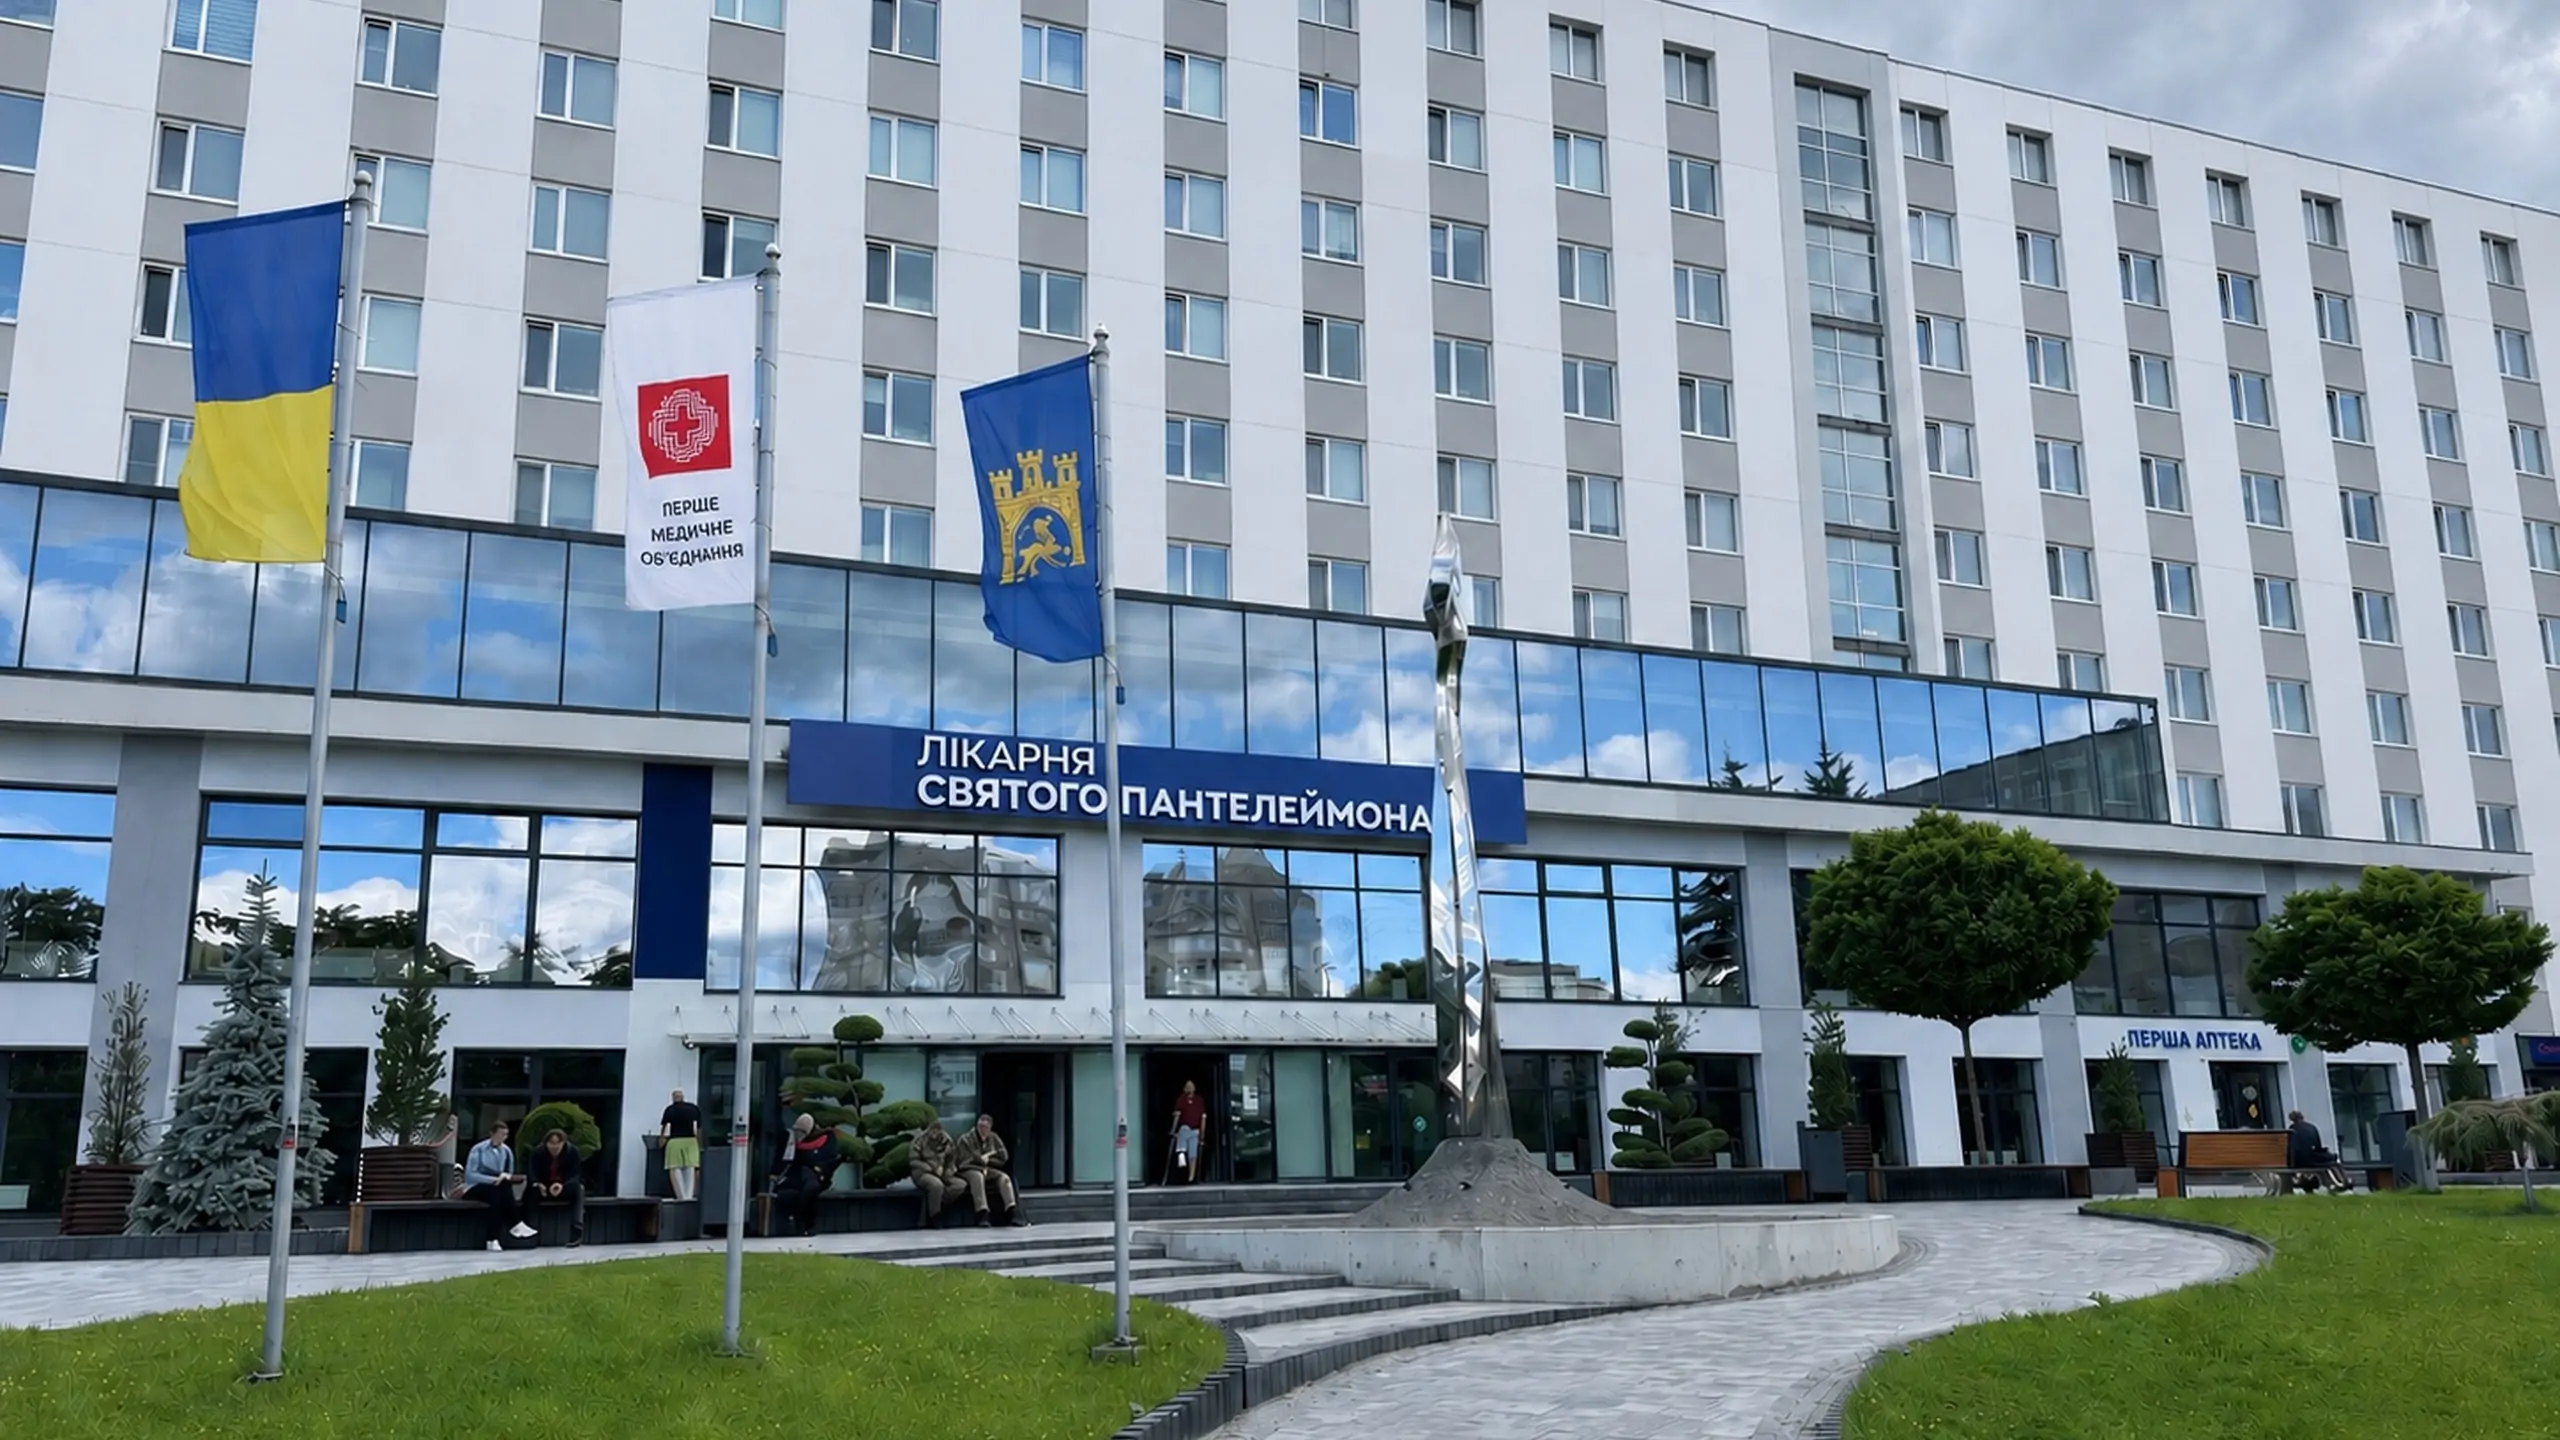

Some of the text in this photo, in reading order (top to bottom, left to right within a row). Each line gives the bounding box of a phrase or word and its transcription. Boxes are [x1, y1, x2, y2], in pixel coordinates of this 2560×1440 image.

[661, 496, 719, 517] ПЕРШЕ
[650, 519, 734, 542] МЕДИЧНЕ
[917, 735, 1095, 776] ЛІКАРНЯ
[917, 774, 1433, 833] СВЯТОГО ПАНТЕЛЕЙМОНА
[2127, 1029, 2262, 1051] ПЕРША АПТЕКА
